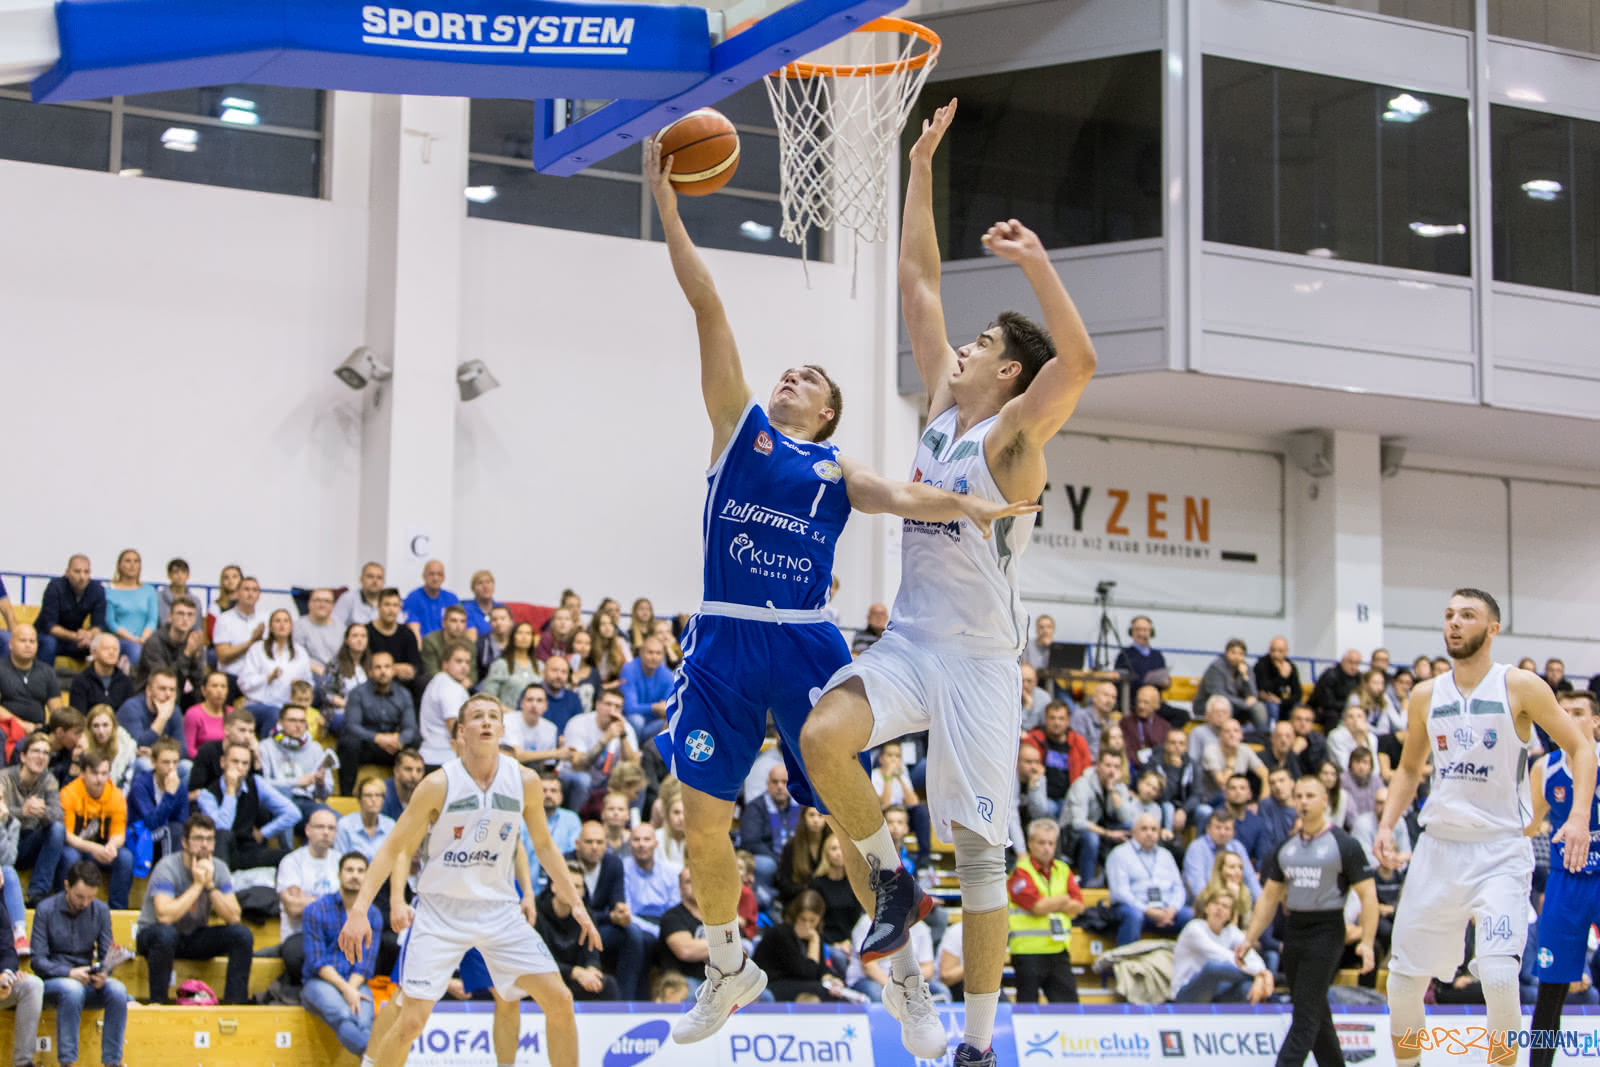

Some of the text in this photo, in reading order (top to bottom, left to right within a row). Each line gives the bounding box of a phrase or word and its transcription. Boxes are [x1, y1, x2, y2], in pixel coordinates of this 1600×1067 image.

[809, 483, 827, 518] 1
[719, 498, 810, 536] Polfarmex
[410, 533, 430, 559] C
[1109, 540, 1140, 554] KLUB
[1146, 543, 1210, 560] SPORTOWY
[751, 549, 812, 573] KUTNO
[750, 567, 787, 580] miasto
[474, 819, 491, 843] 6
[1483, 915, 1512, 941] 14
[198, 1034, 206, 1046] 4
[280, 1034, 288, 1046] 3
[610, 1036, 660, 1057] atrem
[1060, 1031, 1150, 1052] funclub
